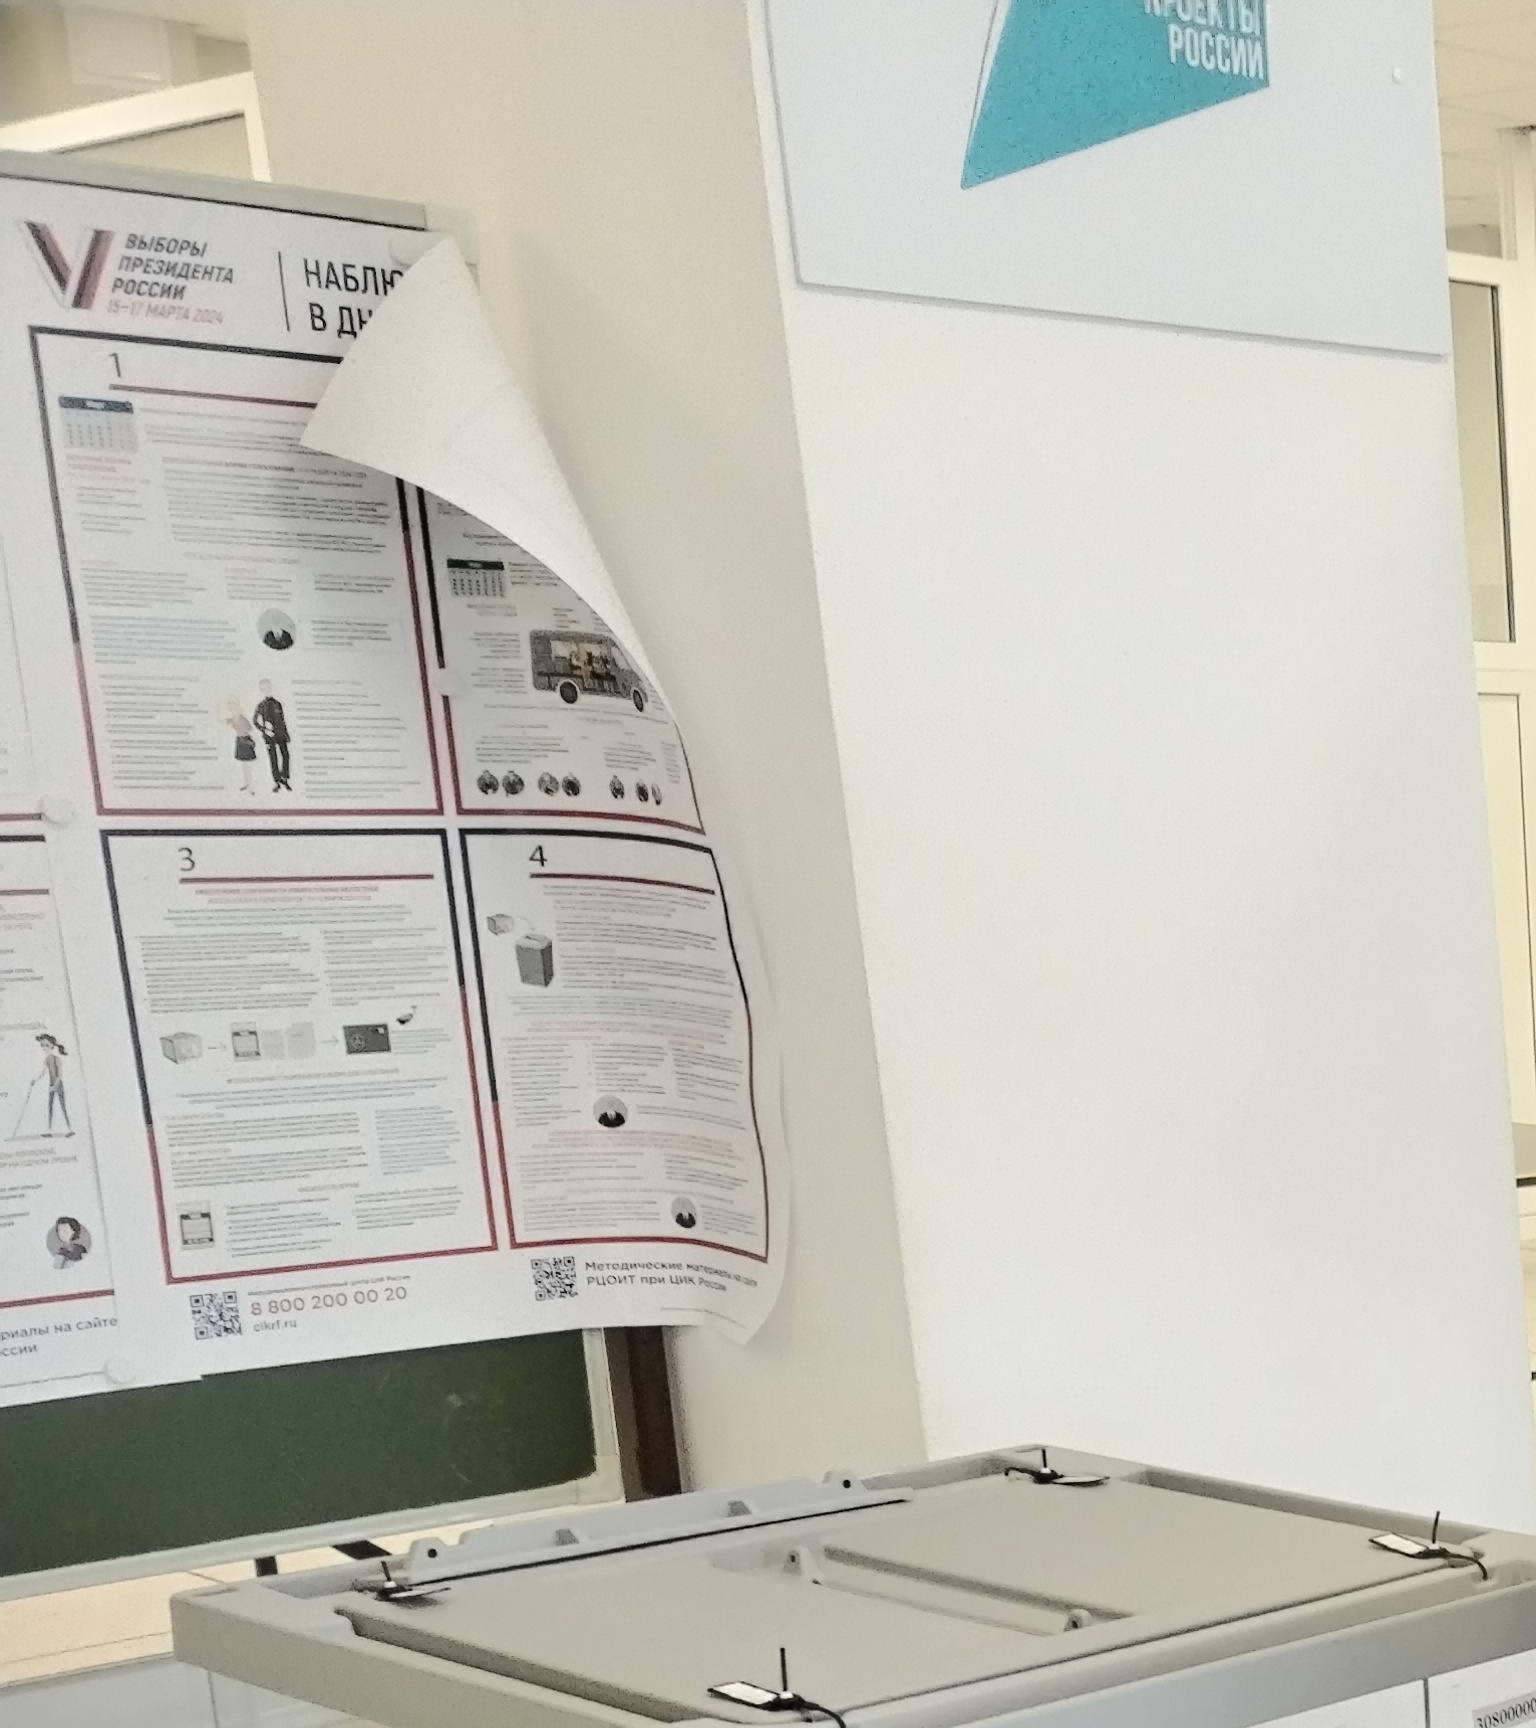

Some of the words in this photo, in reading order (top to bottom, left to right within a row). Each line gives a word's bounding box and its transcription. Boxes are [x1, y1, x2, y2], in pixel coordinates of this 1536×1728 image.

[1168, 23, 1264, 80] РОССИИ
[125, 233, 208, 258] ВЫБОРЫ
[118, 255, 235, 284] ПРЕЗИДЕНТА
[111, 277, 187, 300] РОССИИ
[145, 304, 190, 321] МАРТА
[193, 309, 224, 325] 2024
[309, 302, 327, 332] В
[108, 353, 122, 379] 1
[179, 847, 196, 872] 3
[529, 845, 548, 868] 4
[585, 1261, 683, 1272] Методические
[587, 1275, 636, 1286] РЦОИТ
[641, 1276, 665, 1286] при
[670, 1275, 695, 1287] ЦИК
[251, 1302, 262, 1316] 8
[268, 1297, 305, 1314] 800
[312, 1292, 347, 1310] 200
[353, 1289, 379, 1305] 00
[384, 1286, 408, 1302] 20
[54, 1323, 72, 1334] на
[76, 1317, 118, 1330] сайте
[0, 1344, 37, 1357] ссии
